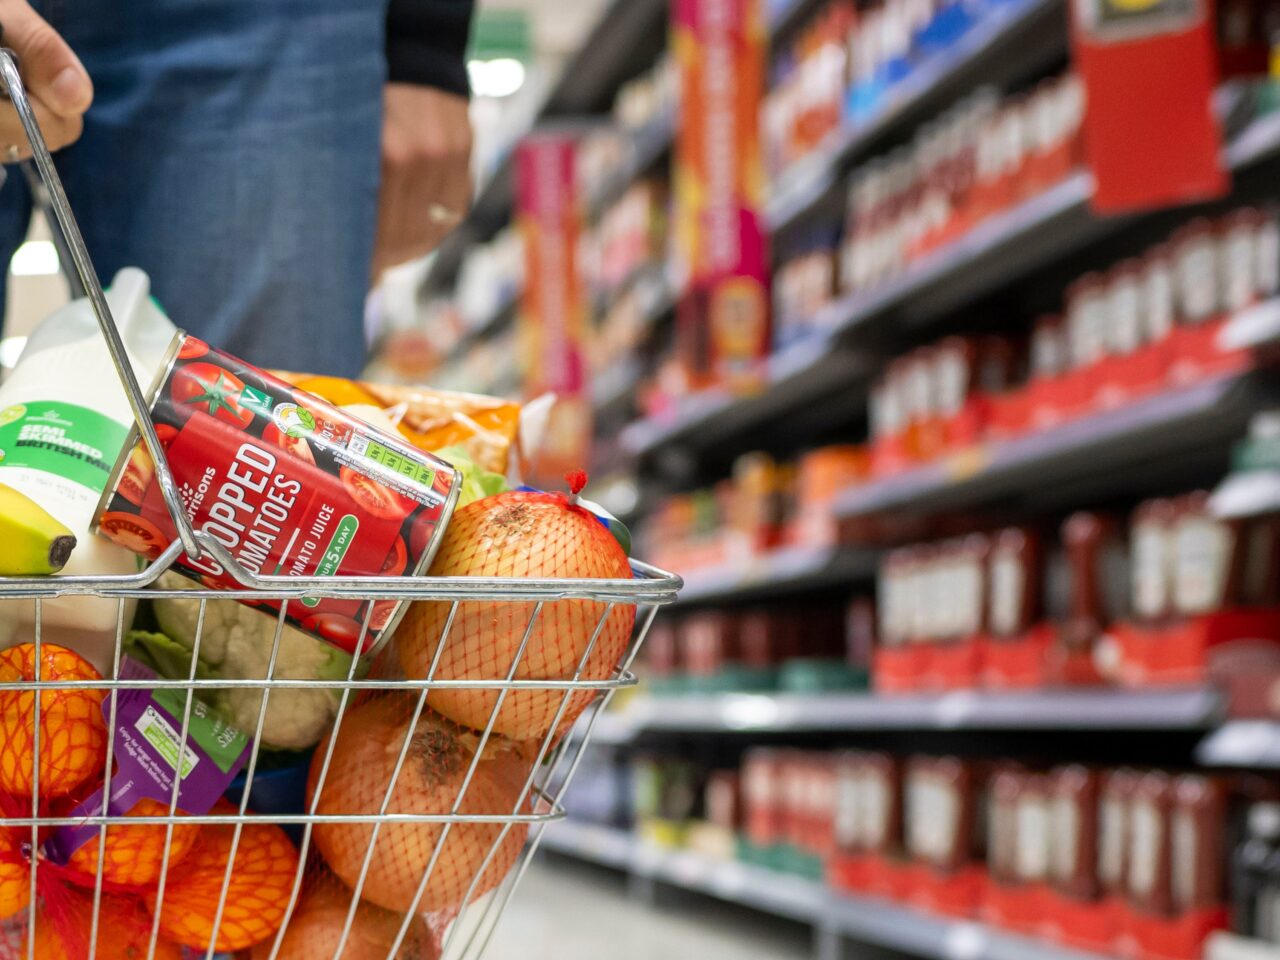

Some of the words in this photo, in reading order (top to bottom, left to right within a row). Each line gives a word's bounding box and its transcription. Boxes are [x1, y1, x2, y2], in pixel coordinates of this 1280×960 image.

[16, 440, 83, 459] BRITISH
[18, 431, 103, 458] SKIMMED
[22, 424, 65, 437] SEMI
[187, 443, 277, 575] COPPED
[188, 466, 216, 522] orrisons
[237, 474, 301, 575] OMATOES
[289, 540, 317, 576] OMATO
[310, 503, 335, 540] JUICE
[326, 550, 340, 564] 5
[333, 545, 341, 553] A
[339, 525, 351, 545] DAY
